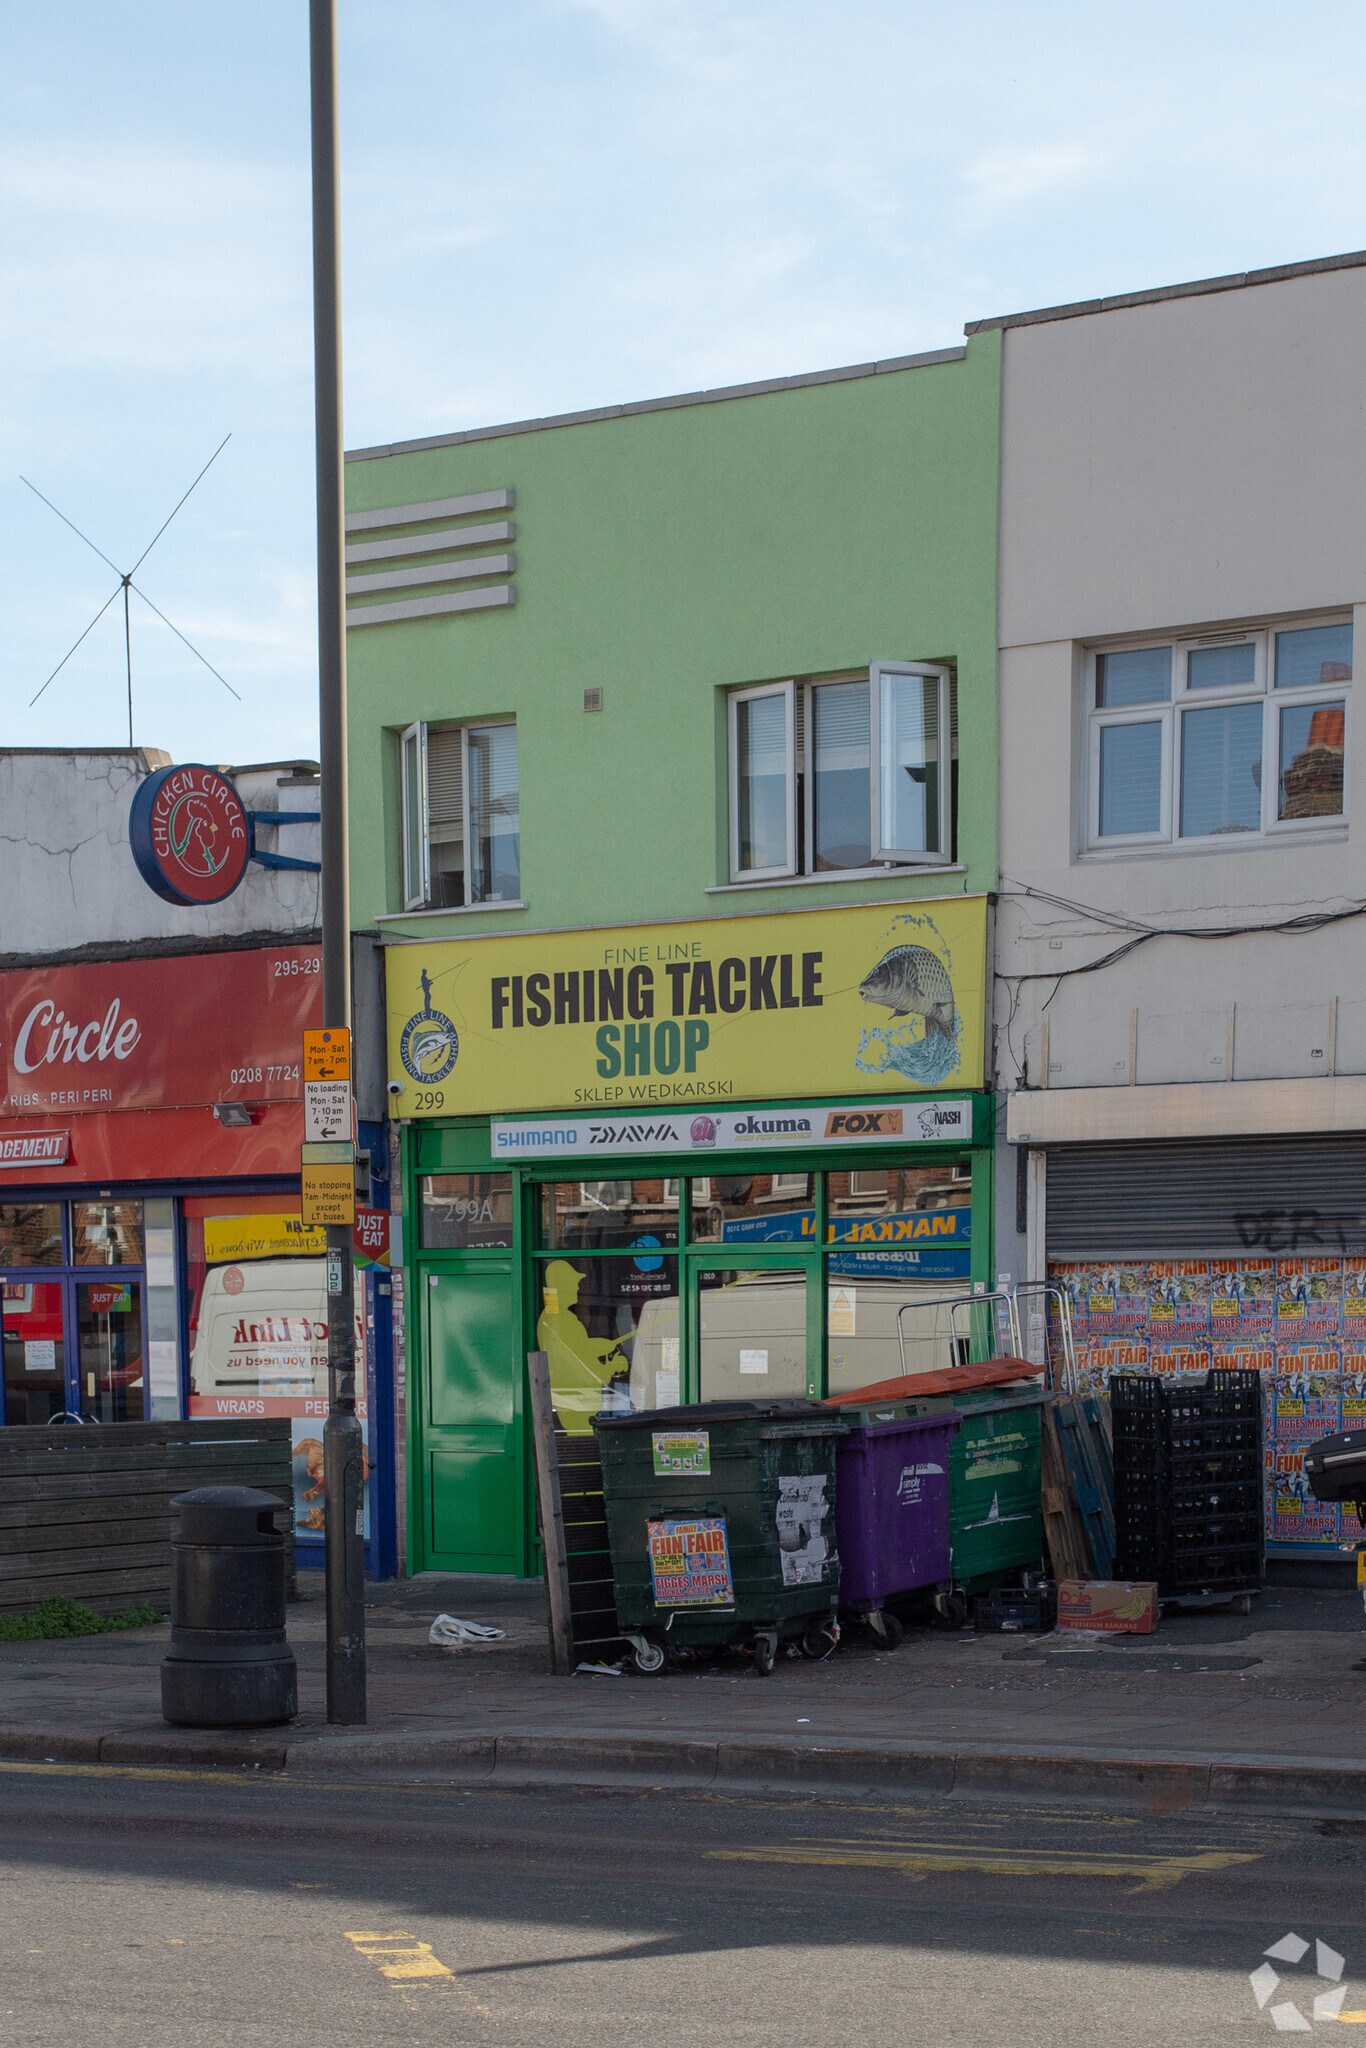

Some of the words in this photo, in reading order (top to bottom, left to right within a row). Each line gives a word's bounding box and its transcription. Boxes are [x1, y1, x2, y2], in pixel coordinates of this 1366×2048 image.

[153, 770, 194, 857] CHICKEN
[201, 774, 245, 839] CIRCLE
[604, 946, 649, 965] FINE
[657, 942, 702, 960] LINE
[273, 957, 324, 977] 295-29
[491, 964, 655, 1029] FISHING
[665, 951, 824, 1016] TACKLE
[406, 1010, 427, 1033] FINE
[430, 1010, 453, 1030] LINE
[13, 997, 142, 1074] Circle
[310, 1046, 326, 1054] Mon
[331, 1044, 345, 1052] Sat
[401, 1037, 419, 1079] FISHING
[420, 1062, 453, 1083] TACKLE
[449, 1032, 458, 1063] SHOP
[596, 1018, 710, 1080] SHOP
[230, 1068, 262, 1084] 0208
[11, 1093, 39, 1106] RIBS
[51, 1090, 79, 1104] PERI
[84, 1089, 113, 1102] PERI
[307, 1085, 318, 1093] No
[320, 1084, 348, 1094] loading
[574, 1086, 624, 1102] SKLEP
[628, 1080, 733, 1101] WĘDKARSKI
[310, 1097, 327, 1105] Mon
[332, 1096, 345, 1104] Sat
[414, 1091, 445, 1110] 299
[497, 1129, 578, 1147] SHIMANO
[734, 1115, 811, 1134] okuma
[830, 1113, 884, 1134] FOX
[934, 1111, 961, 1125] NASH
[305, 1181, 316, 1190] No
[319, 1181, 351, 1191] stopping
[315, 1203, 341, 1212] except
[443, 1199, 494, 1222] 299A
[311, 1212, 320, 1221] LT
[323, 1212, 345, 1221] buses
[357, 1214, 384, 1232] JUST
[362, 1231, 384, 1246] EAT
[1149, 1261, 1175, 1278] FUN
[1176, 1260, 1208, 1276] FAIR
[1277, 1259, 1304, 1277] FUN
[1307, 1257, 1340, 1274] FAIR
[92, 1292, 112, 1304] JUST
[112, 1291, 129, 1303] EAT
[1118, 1313, 1147, 1323] MARSH
[1179, 1321, 1208, 1332] MARSH
[1211, 1318, 1241, 1328] FIGGES
[1243, 1317, 1273, 1328] MARSH
[1278, 1321, 1306, 1331] FIGGES
[1309, 1320, 1339, 1331] MARSH
[1090, 1351, 1115, 1367] FUN
[1118, 1347, 1148, 1365] FAIR
[1151, 1354, 1177, 1373] FUN
[1179, 1352, 1210, 1371] FAIR
[1213, 1355, 1239, 1370] FUN
[1242, 1351, 1273, 1370] FAIR
[1278, 1355, 1304, 1374] FUN
[1307, 1352, 1339, 1372] FAIR
[216, 1400, 265, 1414] WRAPS
[1277, 1419, 1306, 1428] FIGGES
[1307, 1418, 1337, 1428] MARSH
[1342, 1419, 1365, 1428] FIGGE
[1276, 1455, 1303, 1472] FUN
[676, 1524, 698, 1534] FAMILY
[1276, 1517, 1303, 1527] FIGGES
[1306, 1516, 1336, 1526] MARSH
[686, 1530, 725, 1553] FAIR
[655, 1576, 690, 1588] FIGGES
[692, 1573, 729, 1586] MARSH
[1060, 1591, 1092, 1604] Dole
